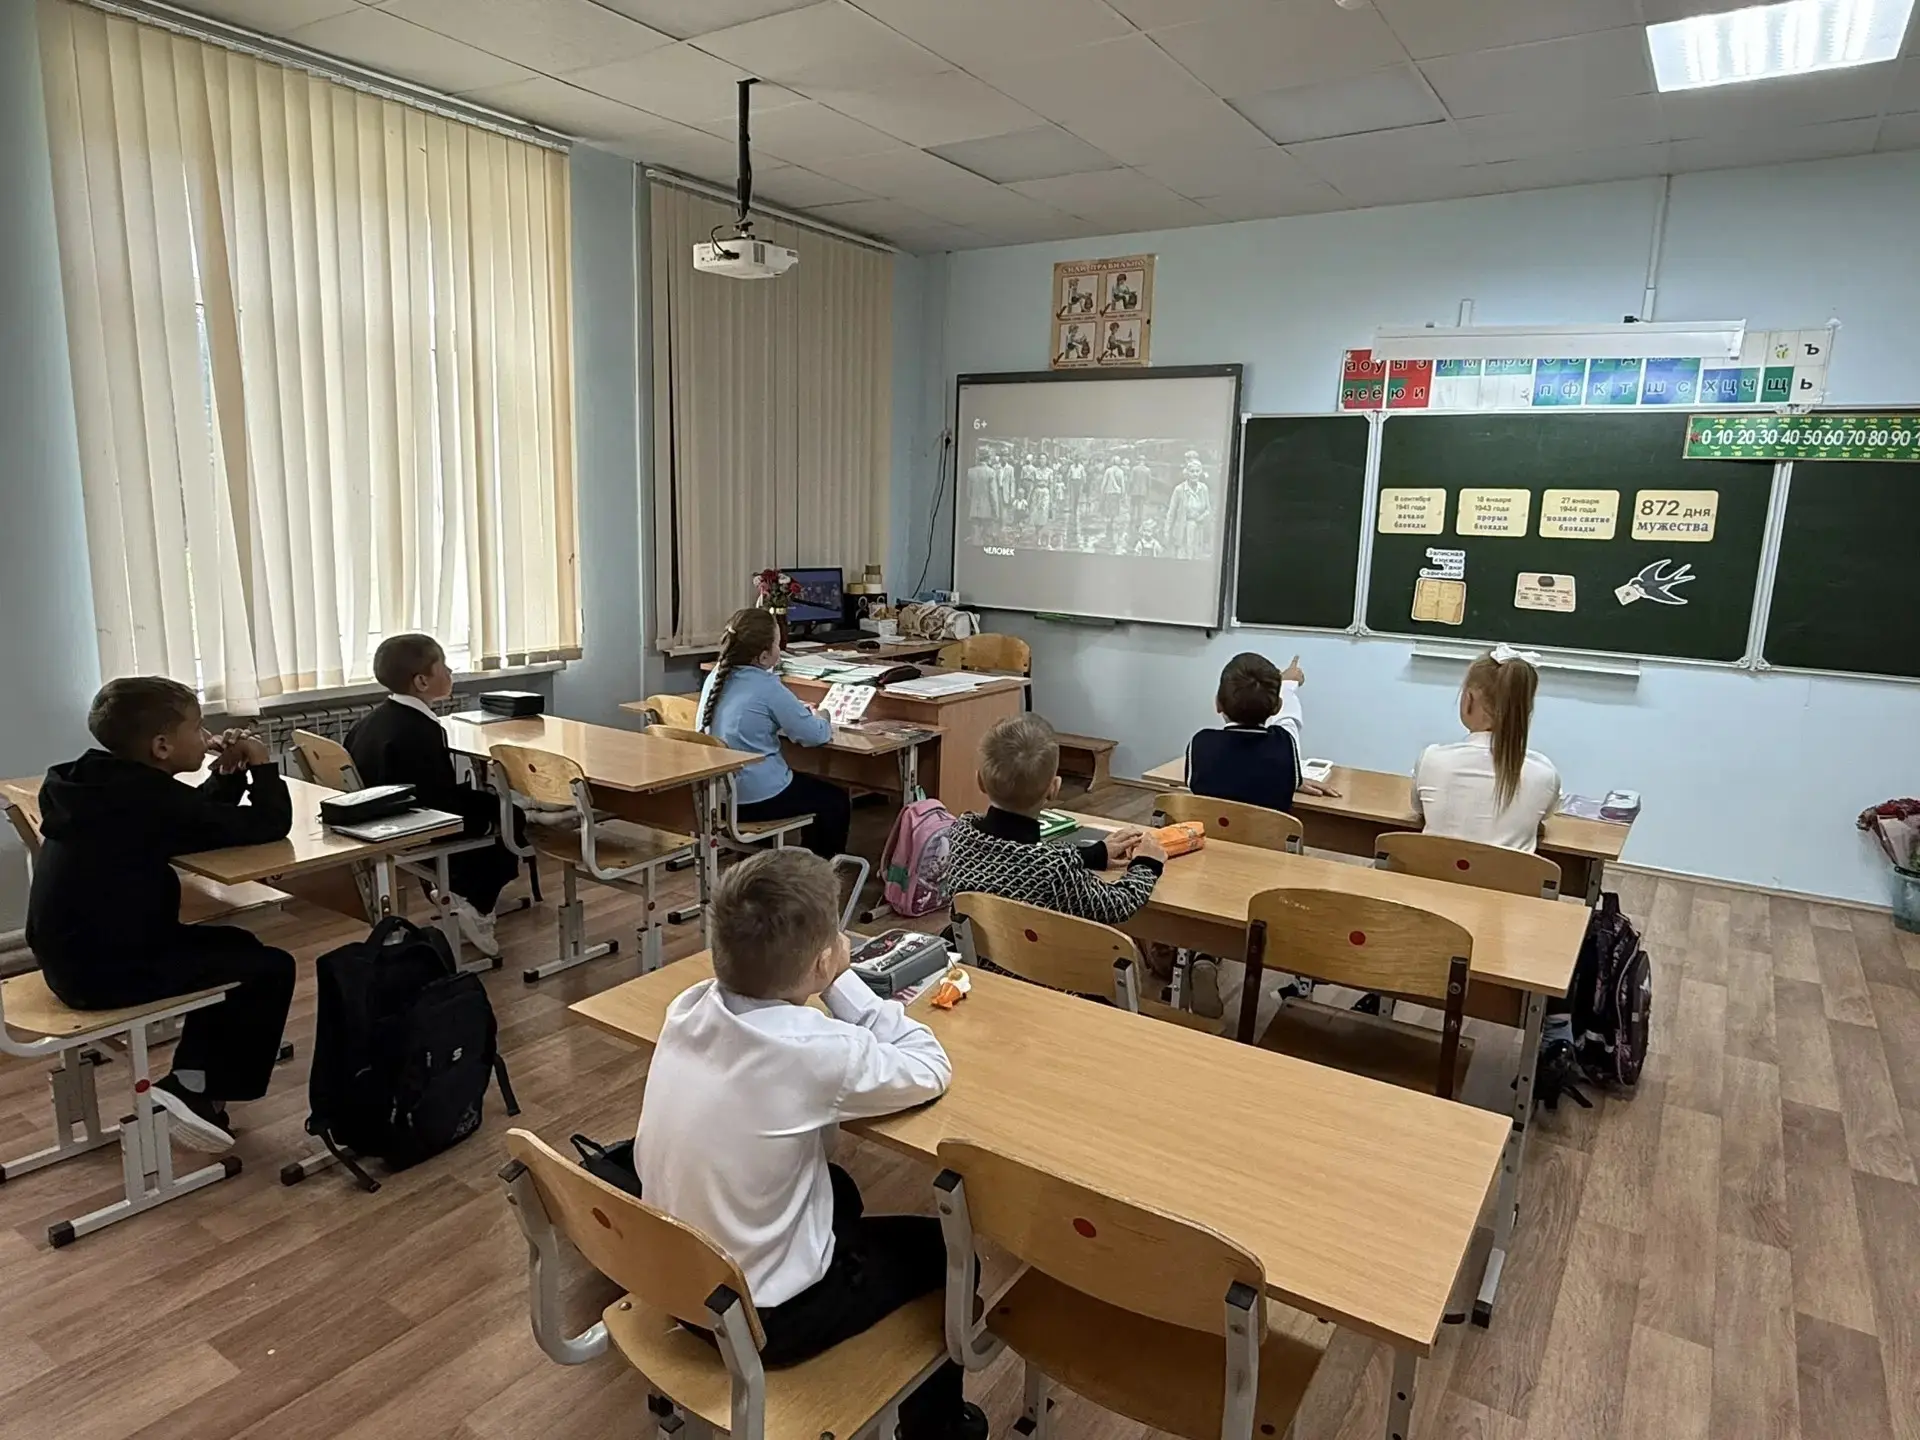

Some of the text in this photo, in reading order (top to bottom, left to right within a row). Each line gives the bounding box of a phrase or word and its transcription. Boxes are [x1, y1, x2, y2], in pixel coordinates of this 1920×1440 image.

[973, 418, 988, 430] 6+
[1701, 429, 1712, 445] 0
[1716, 429, 1733, 445] 10
[1736, 429, 1756, 445] 20
[1758, 429, 1778, 445] 30
[1780, 429, 1800, 445] 40
[1803, 429, 1822, 445] 50
[1824, 429, 1844, 445] 60
[1847, 429, 1865, 445] 70
[1868, 430, 1888, 446] 80
[1891, 430, 1911, 446] 90
[1640, 500, 1711, 518] 872 дня
[1474, 523, 1508, 531] блокады
[1558, 524, 1595, 532] блокады
[1636, 521, 1709, 534] мужества
[983, 546, 1015, 556] ЧЕЛОВЕК
